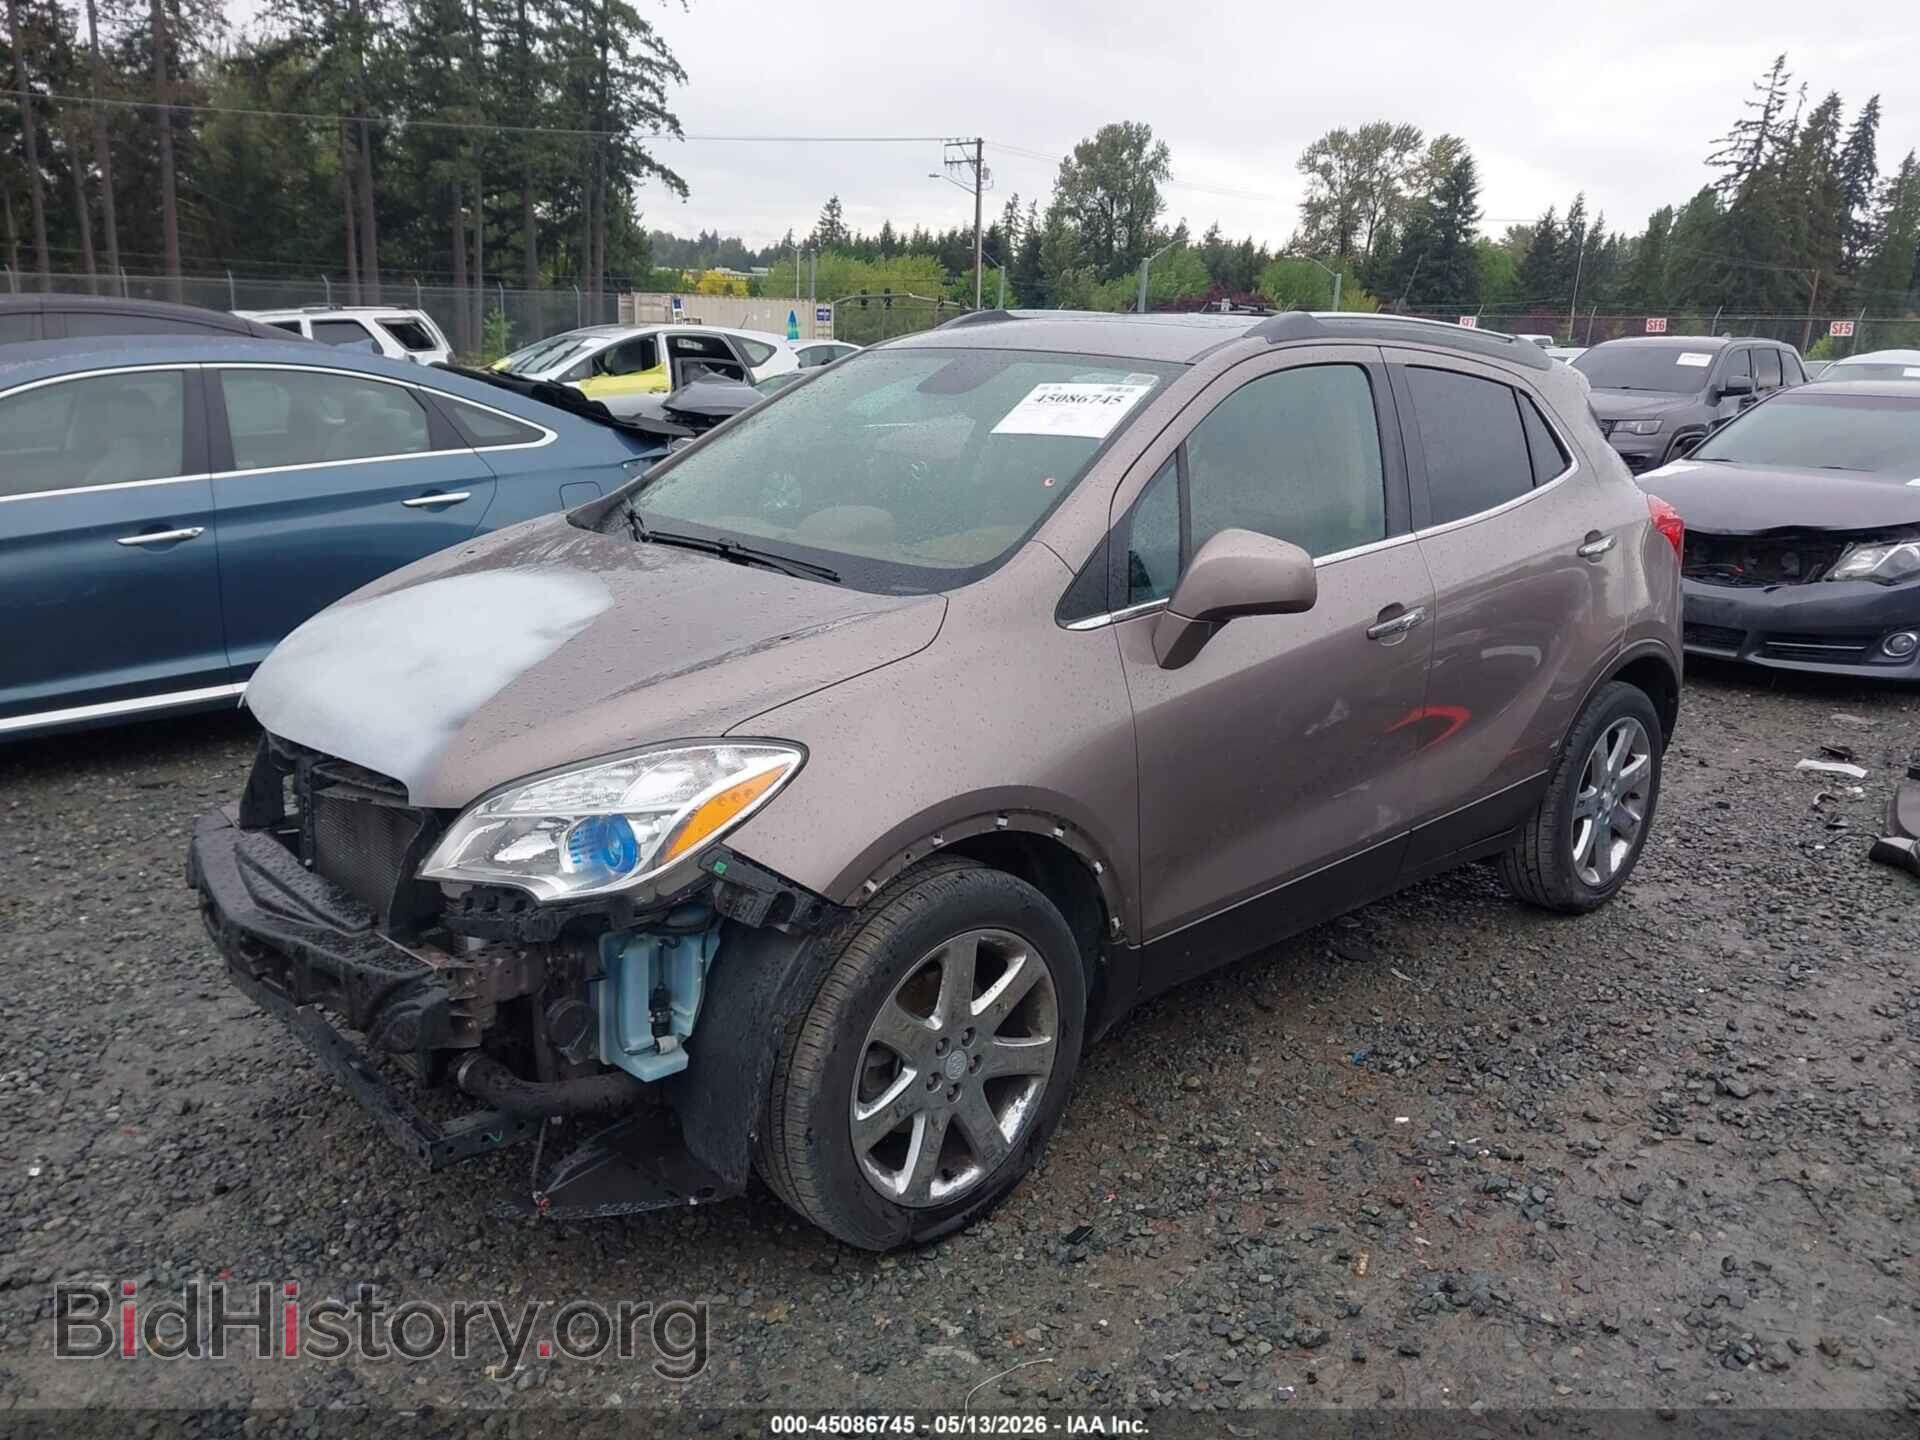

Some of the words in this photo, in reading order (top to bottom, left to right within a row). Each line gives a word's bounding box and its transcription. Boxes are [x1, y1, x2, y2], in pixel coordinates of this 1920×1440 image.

[1648, 319, 1665, 330] SF6
[1832, 322, 1852, 334] SF5
[1034, 393, 1125, 405] 45086745
